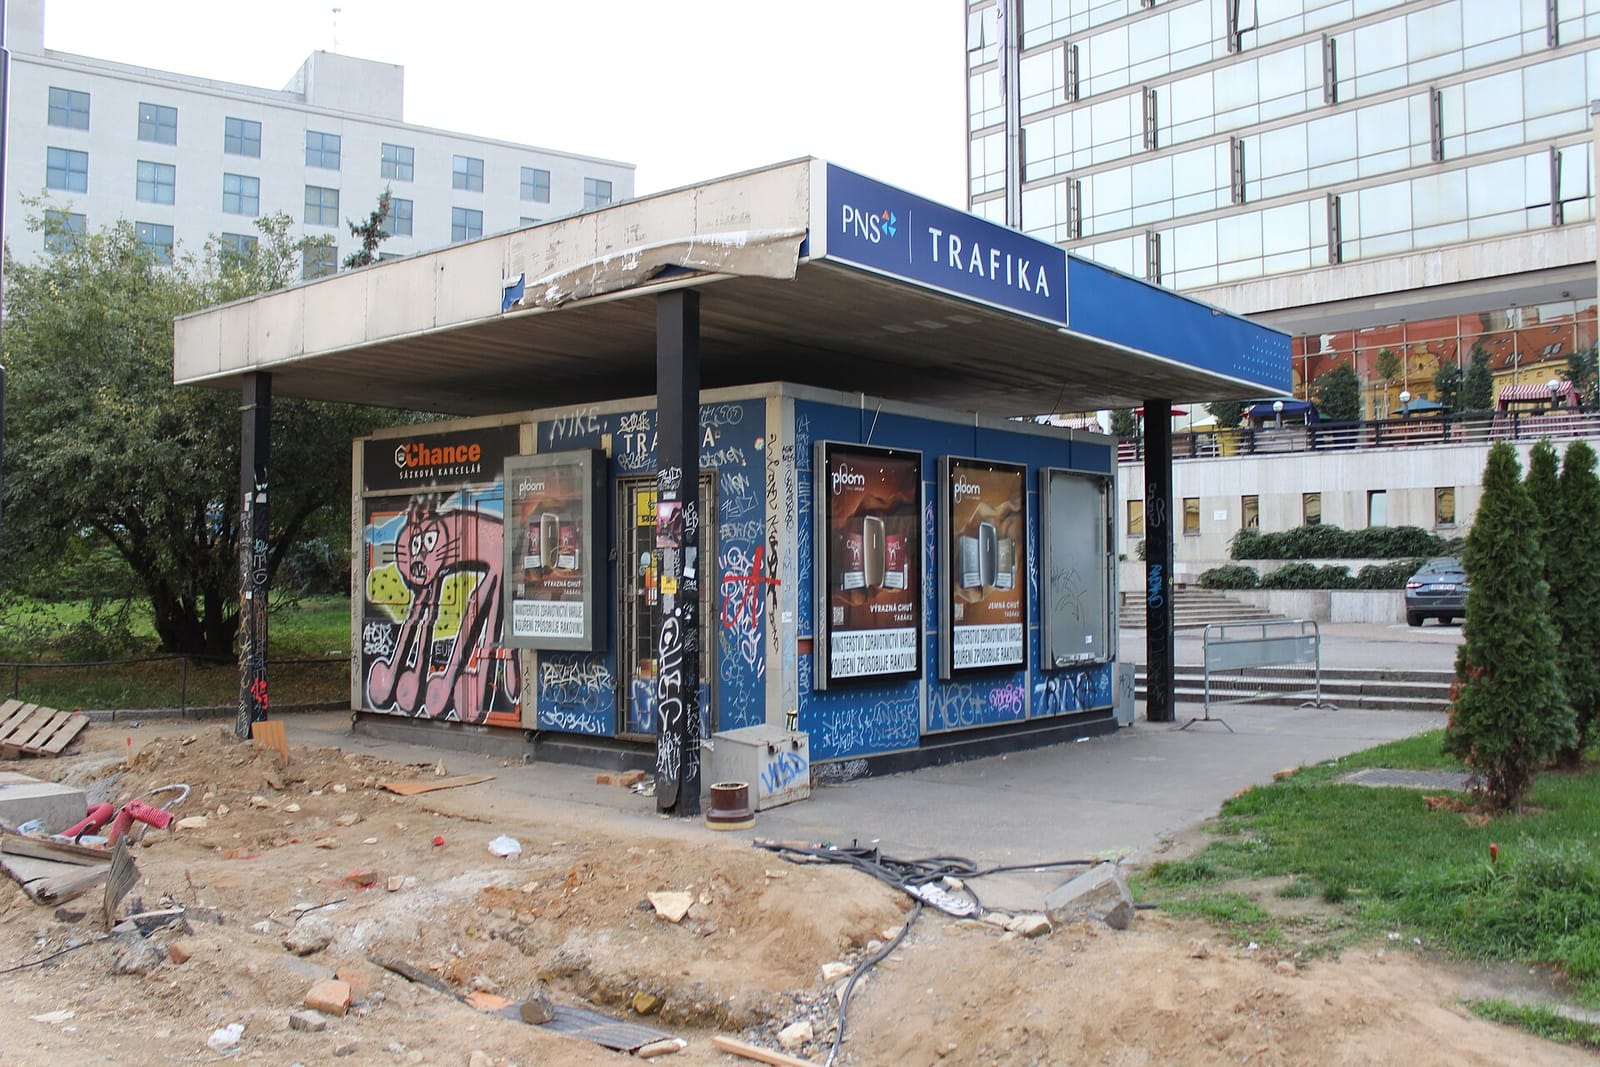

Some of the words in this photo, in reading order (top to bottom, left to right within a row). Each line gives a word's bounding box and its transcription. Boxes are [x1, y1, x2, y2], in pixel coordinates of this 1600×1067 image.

[843, 204, 881, 244] PNS
[928, 226, 1050, 298] TRAFIKA
[405, 443, 480, 467] Chance
[400, 467, 434, 480] SÁZKOVÁ
[833, 463, 865, 495] ploom
[519, 477, 546, 499] ploom
[955, 475, 981, 504] ploom
[870, 602, 897, 613] VÝRAZNÁ
[988, 600, 1006, 610] JEMNÁ
